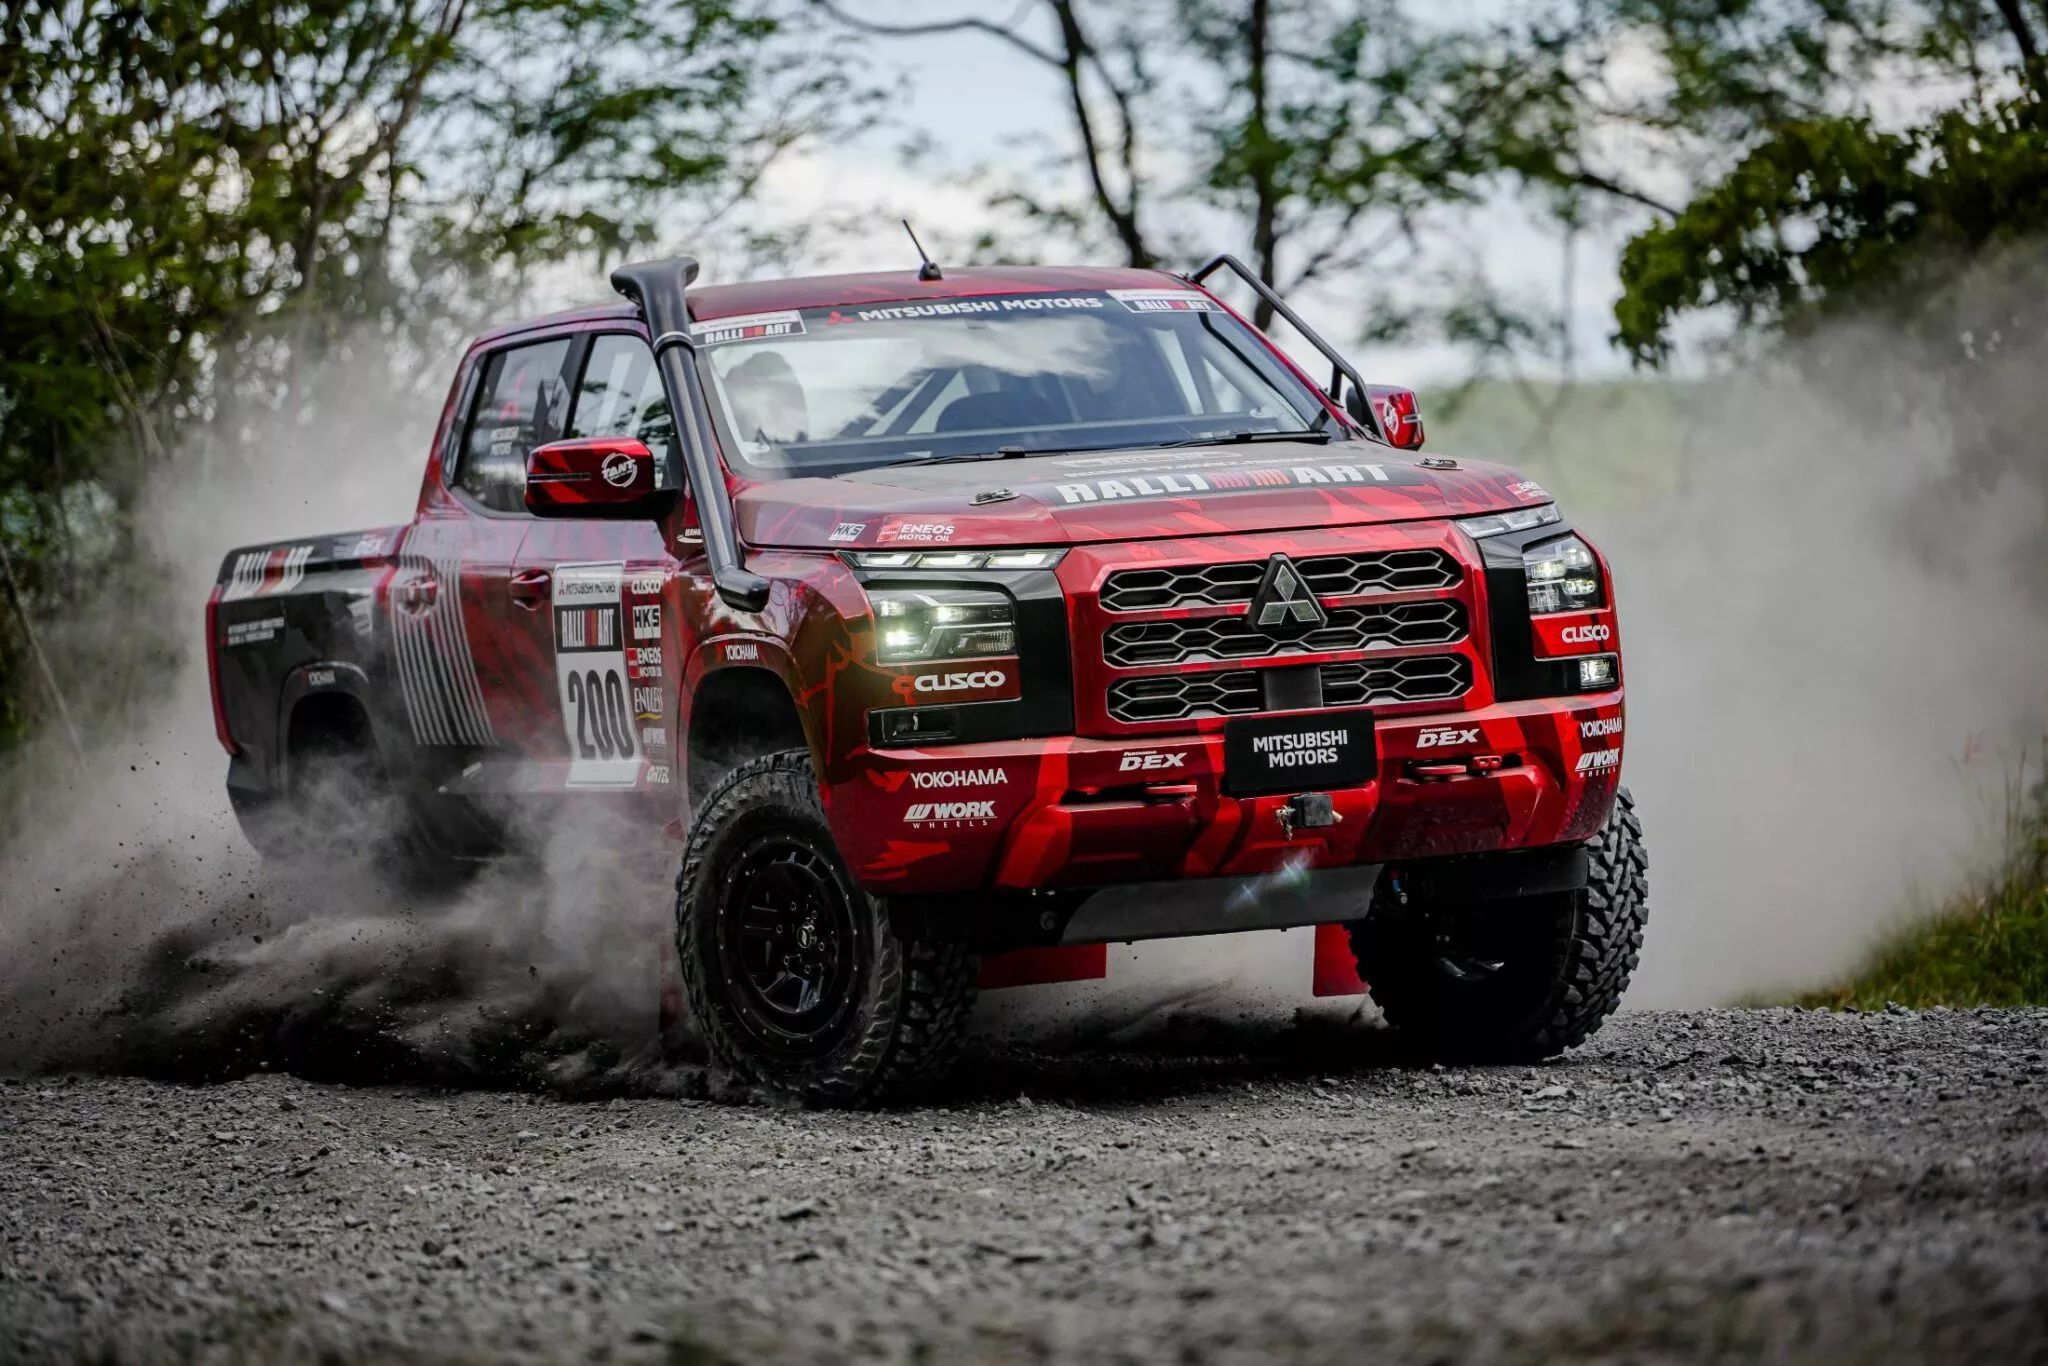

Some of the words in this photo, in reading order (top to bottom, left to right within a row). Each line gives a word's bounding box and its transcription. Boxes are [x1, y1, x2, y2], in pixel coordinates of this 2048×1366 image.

[858, 300, 998, 321] MITSUBISHI
[1003, 297, 1103, 312] MOTORS
[704, 327, 744, 343] RALLI
[765, 322, 793, 336] ART
[1055, 473, 1210, 504] RALLI
[1291, 464, 1390, 484] ART
[833, 522, 864, 536] HKS
[897, 533, 932, 541] MOTOR
[900, 524, 956, 535] ENEOS
[561, 609, 586, 648] RALLI
[597, 608, 615, 647] ART
[634, 606, 661, 629] HKS
[1561, 624, 1611, 644] CUSCO
[637, 647, 662, 665] ENEOS
[725, 644, 759, 661] YOKOHAMA
[914, 670, 1006, 692] CUSCO
[567, 669, 635, 761] 200
[1581, 716, 1623, 739] YOKOHAMA
[1253, 729, 1349, 753] MITSUBISHI
[1416, 728, 1480, 749] DEX
[1119, 752, 1188, 772] DEX
[1268, 748, 1339, 769] MOTORS
[910, 768, 1008, 789] YOKOHAMA
[934, 801, 998, 819] WORK
[912, 820, 988, 830] WHEELS
